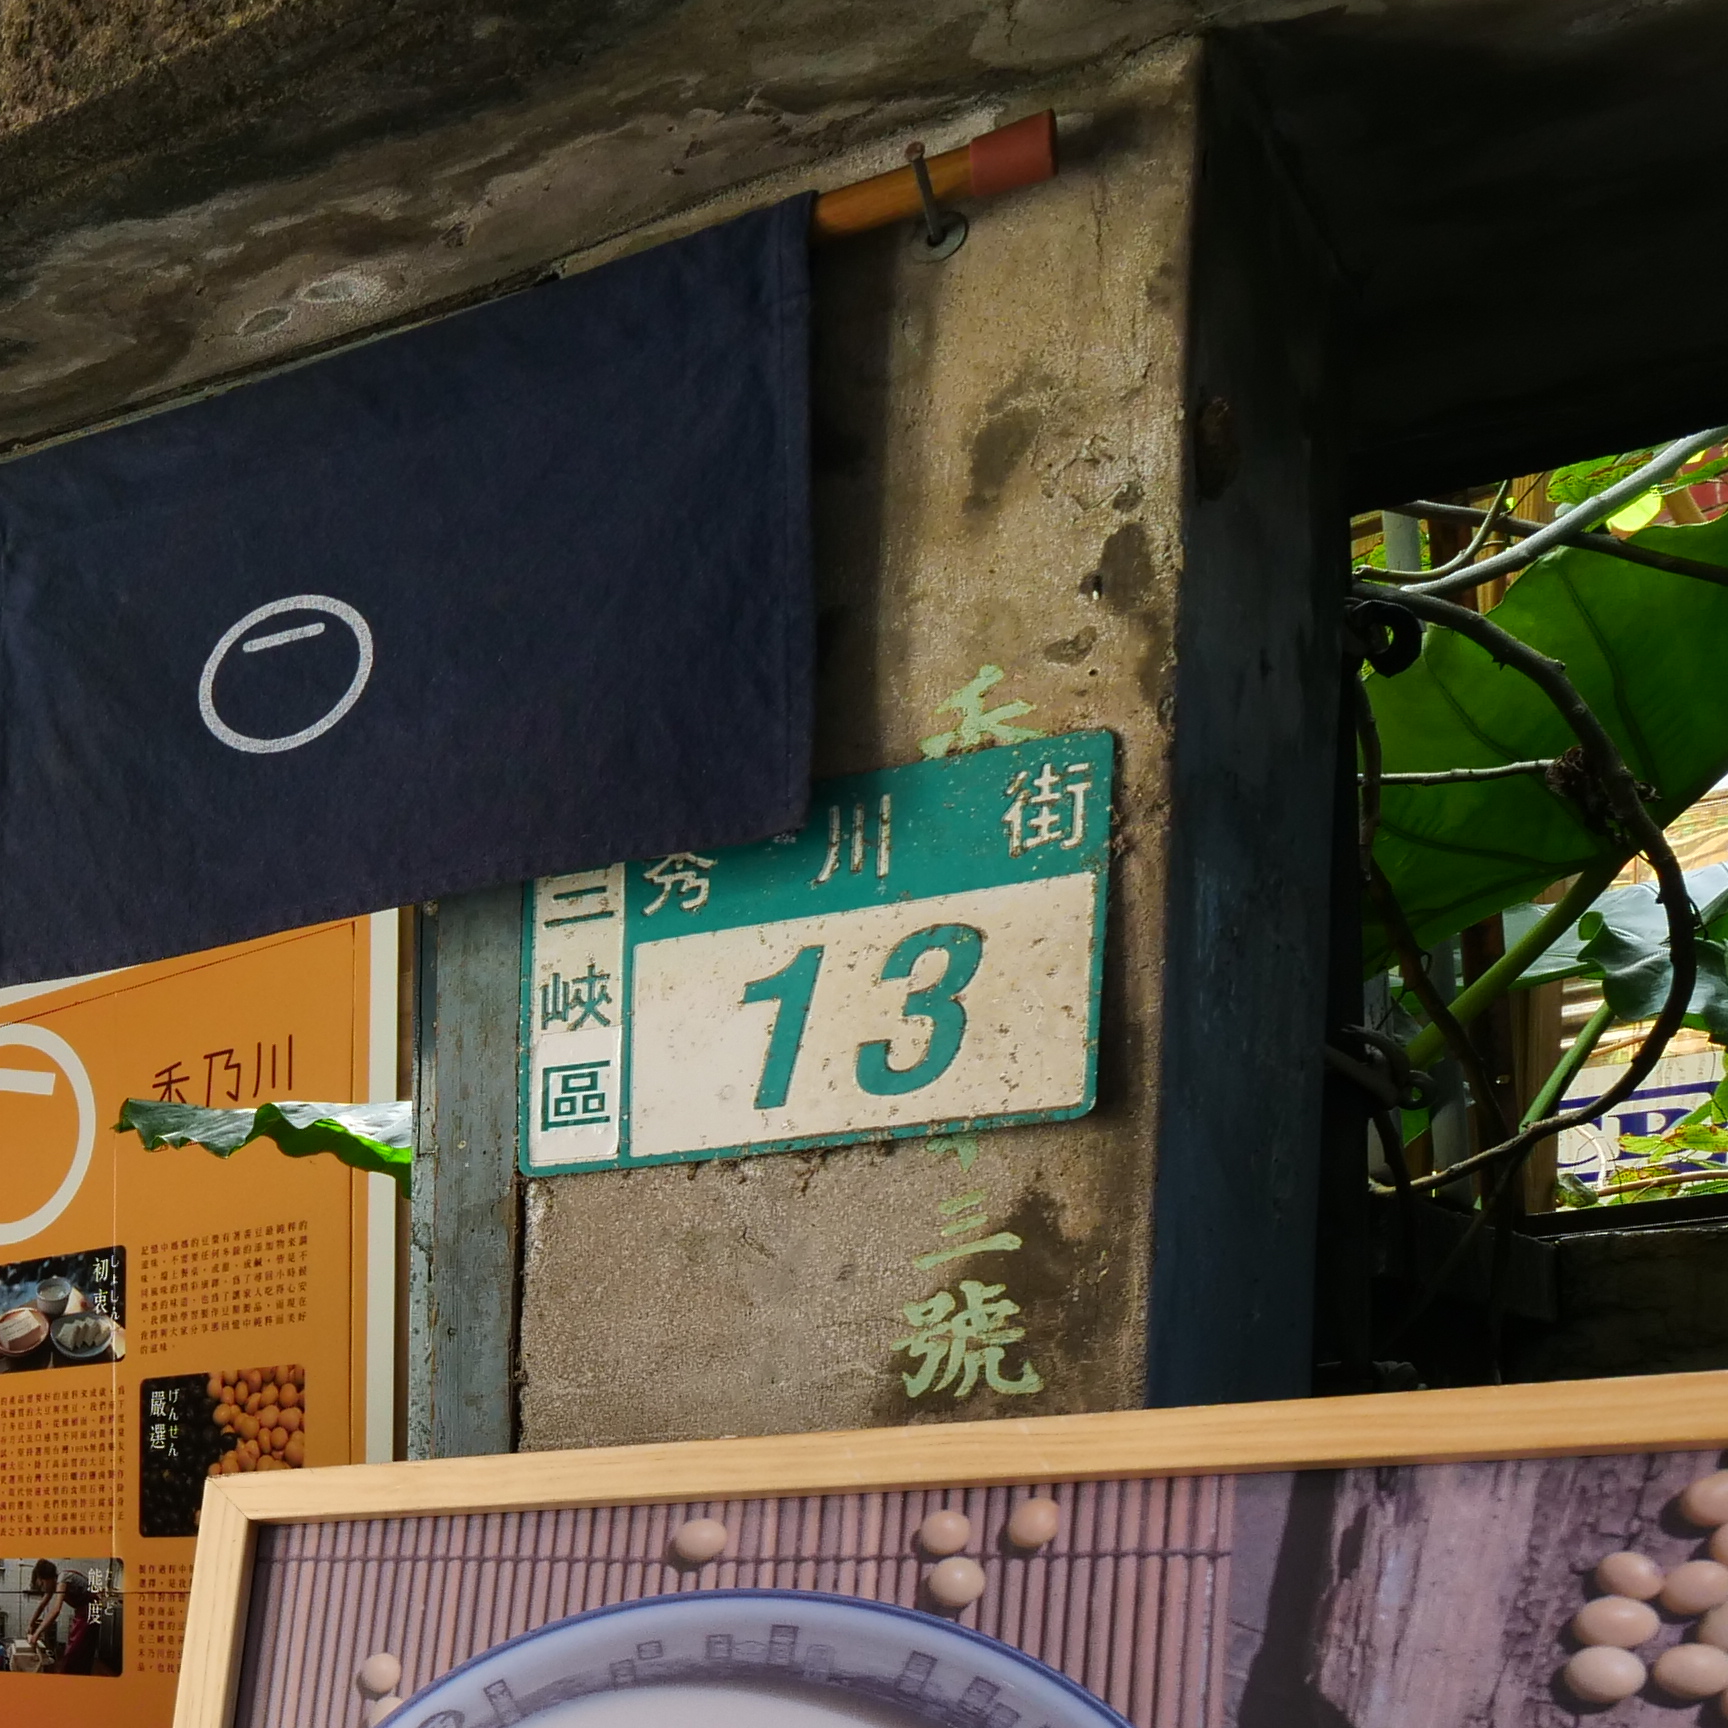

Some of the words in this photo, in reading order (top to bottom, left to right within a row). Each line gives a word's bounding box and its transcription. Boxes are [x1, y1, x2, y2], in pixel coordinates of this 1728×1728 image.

[742, 923, 988, 1110] 13
[151, 1033, 294, 1108] 禾乃川
[92, 1256, 109, 1315] 初衷
[148, 1390, 167, 1451] 嚴選
[167, 1388, 181, 1458] げんせん
[87, 1567, 103, 1625] 態度
